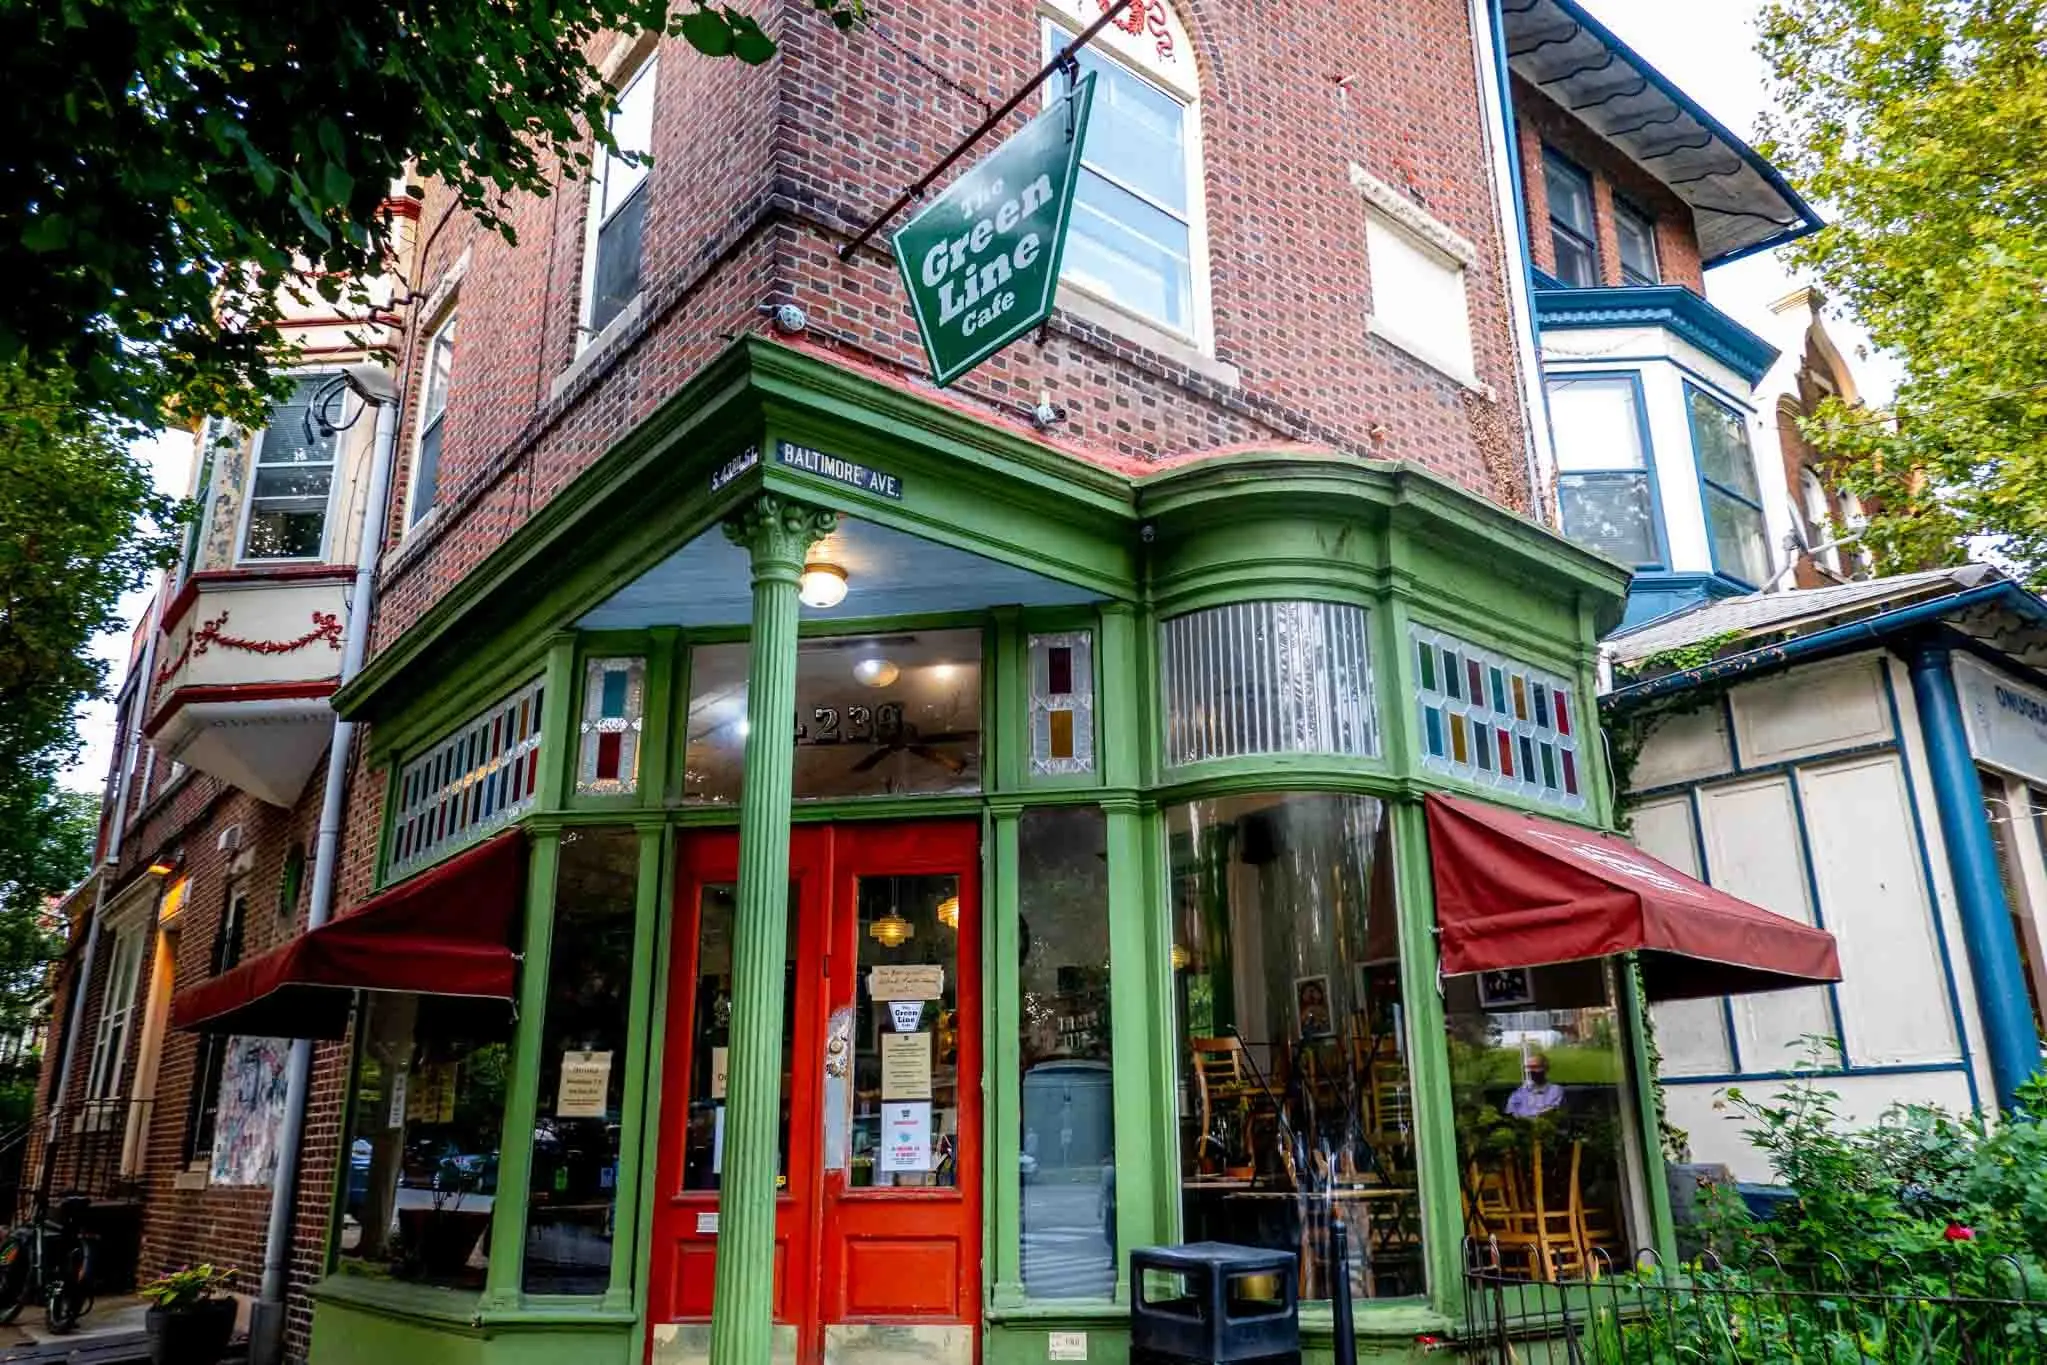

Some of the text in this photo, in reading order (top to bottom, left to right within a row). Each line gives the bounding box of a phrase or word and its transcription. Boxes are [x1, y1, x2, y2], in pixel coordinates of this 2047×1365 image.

[961, 178, 1005, 219] The
[922, 174, 1054, 288] Green
[938, 233, 1041, 327] Line
[962, 291, 1016, 337] Cafe
[784, 443, 900, 497] BALTIMORE AVE.
[797, 703, 904, 743] 239
